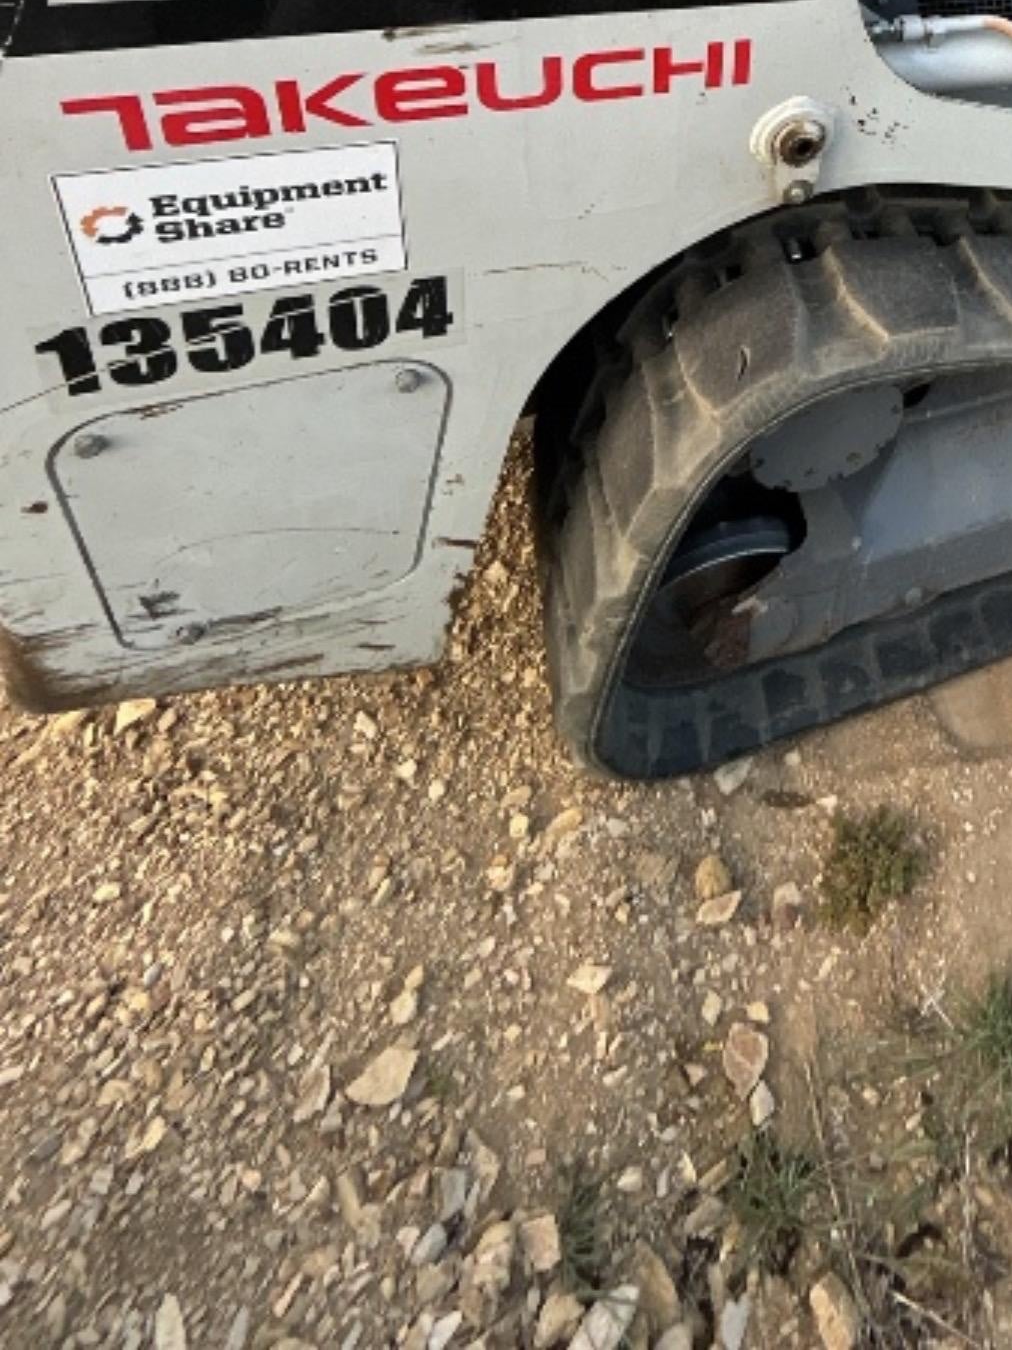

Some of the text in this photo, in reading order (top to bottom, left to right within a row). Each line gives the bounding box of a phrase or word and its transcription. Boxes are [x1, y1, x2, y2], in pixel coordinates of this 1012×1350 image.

[149, 172, 388, 218] Equipment
[154, 210, 286, 244] Share
[35, 276, 454, 396] 135404
